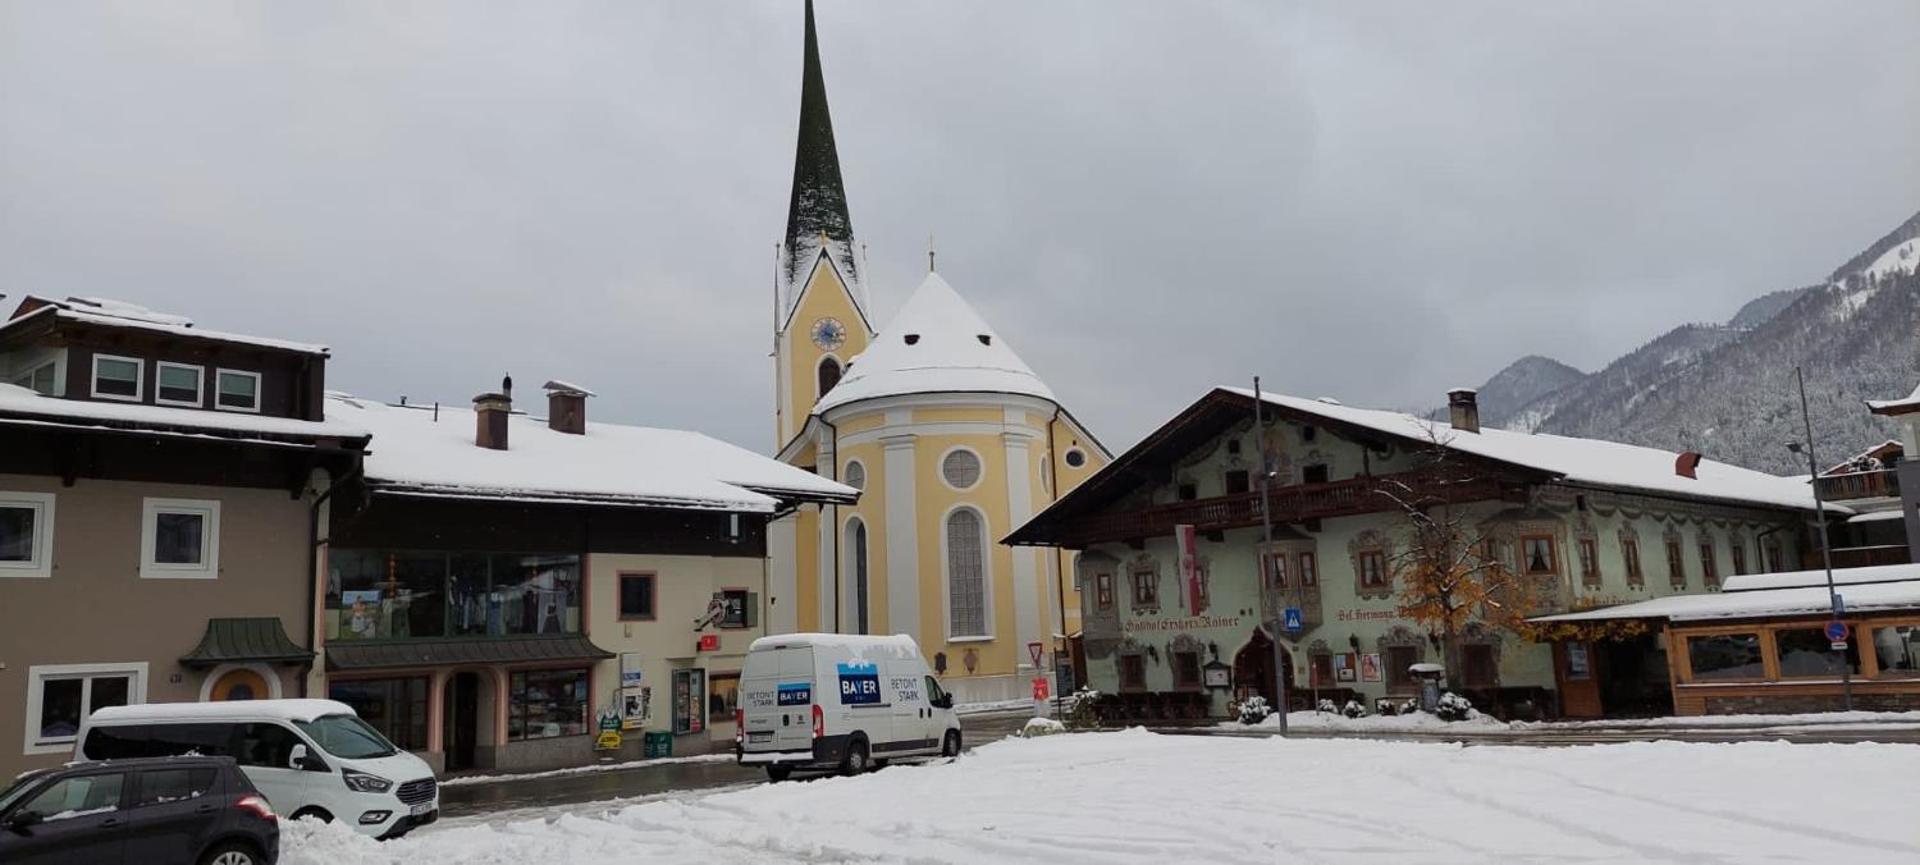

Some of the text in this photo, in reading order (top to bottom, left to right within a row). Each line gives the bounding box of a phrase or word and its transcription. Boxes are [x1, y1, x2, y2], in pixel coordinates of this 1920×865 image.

[841, 680, 877, 694] BAYER
[891, 678, 917, 690] BETONT
[780, 691, 808, 700] BAYER
[898, 690, 920, 702] STARK
